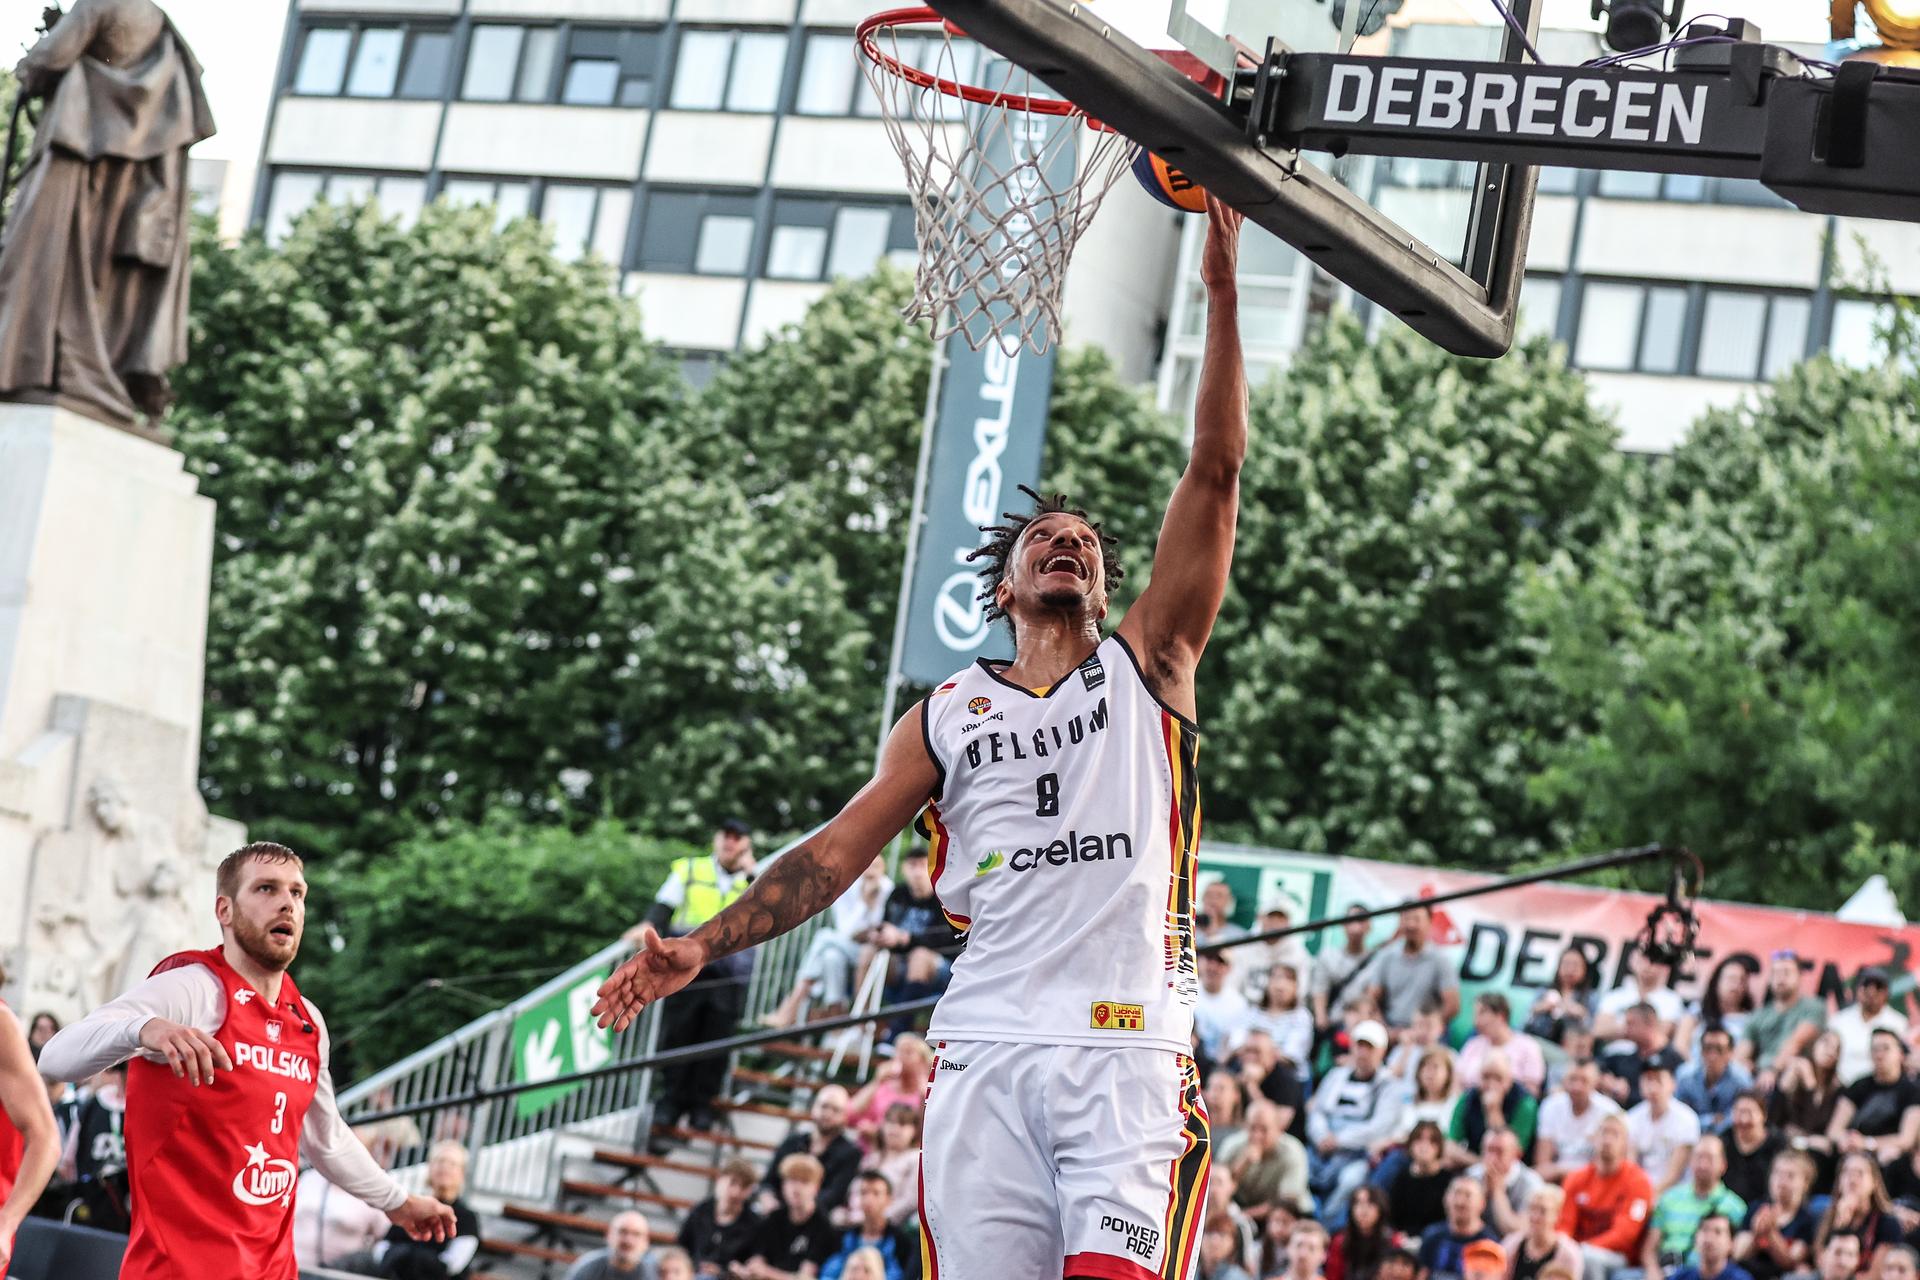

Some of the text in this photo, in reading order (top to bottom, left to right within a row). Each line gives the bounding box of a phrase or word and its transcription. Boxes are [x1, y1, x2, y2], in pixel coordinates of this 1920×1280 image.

[1324, 64, 1708, 144] DEBRECEN
[954, 334, 1020, 567] LEXUS
[1084, 667, 1103, 679] FIBA
[966, 697, 1109, 770] BELGIUM
[1036, 773, 1060, 817] 8
[1009, 831, 1133, 872] crelan
[234, 1042, 312, 1084] POLSKA
[270, 1091, 287, 1135] 3
[1101, 1216, 1159, 1245] POWER
[1126, 1237, 1155, 1260] ADE
